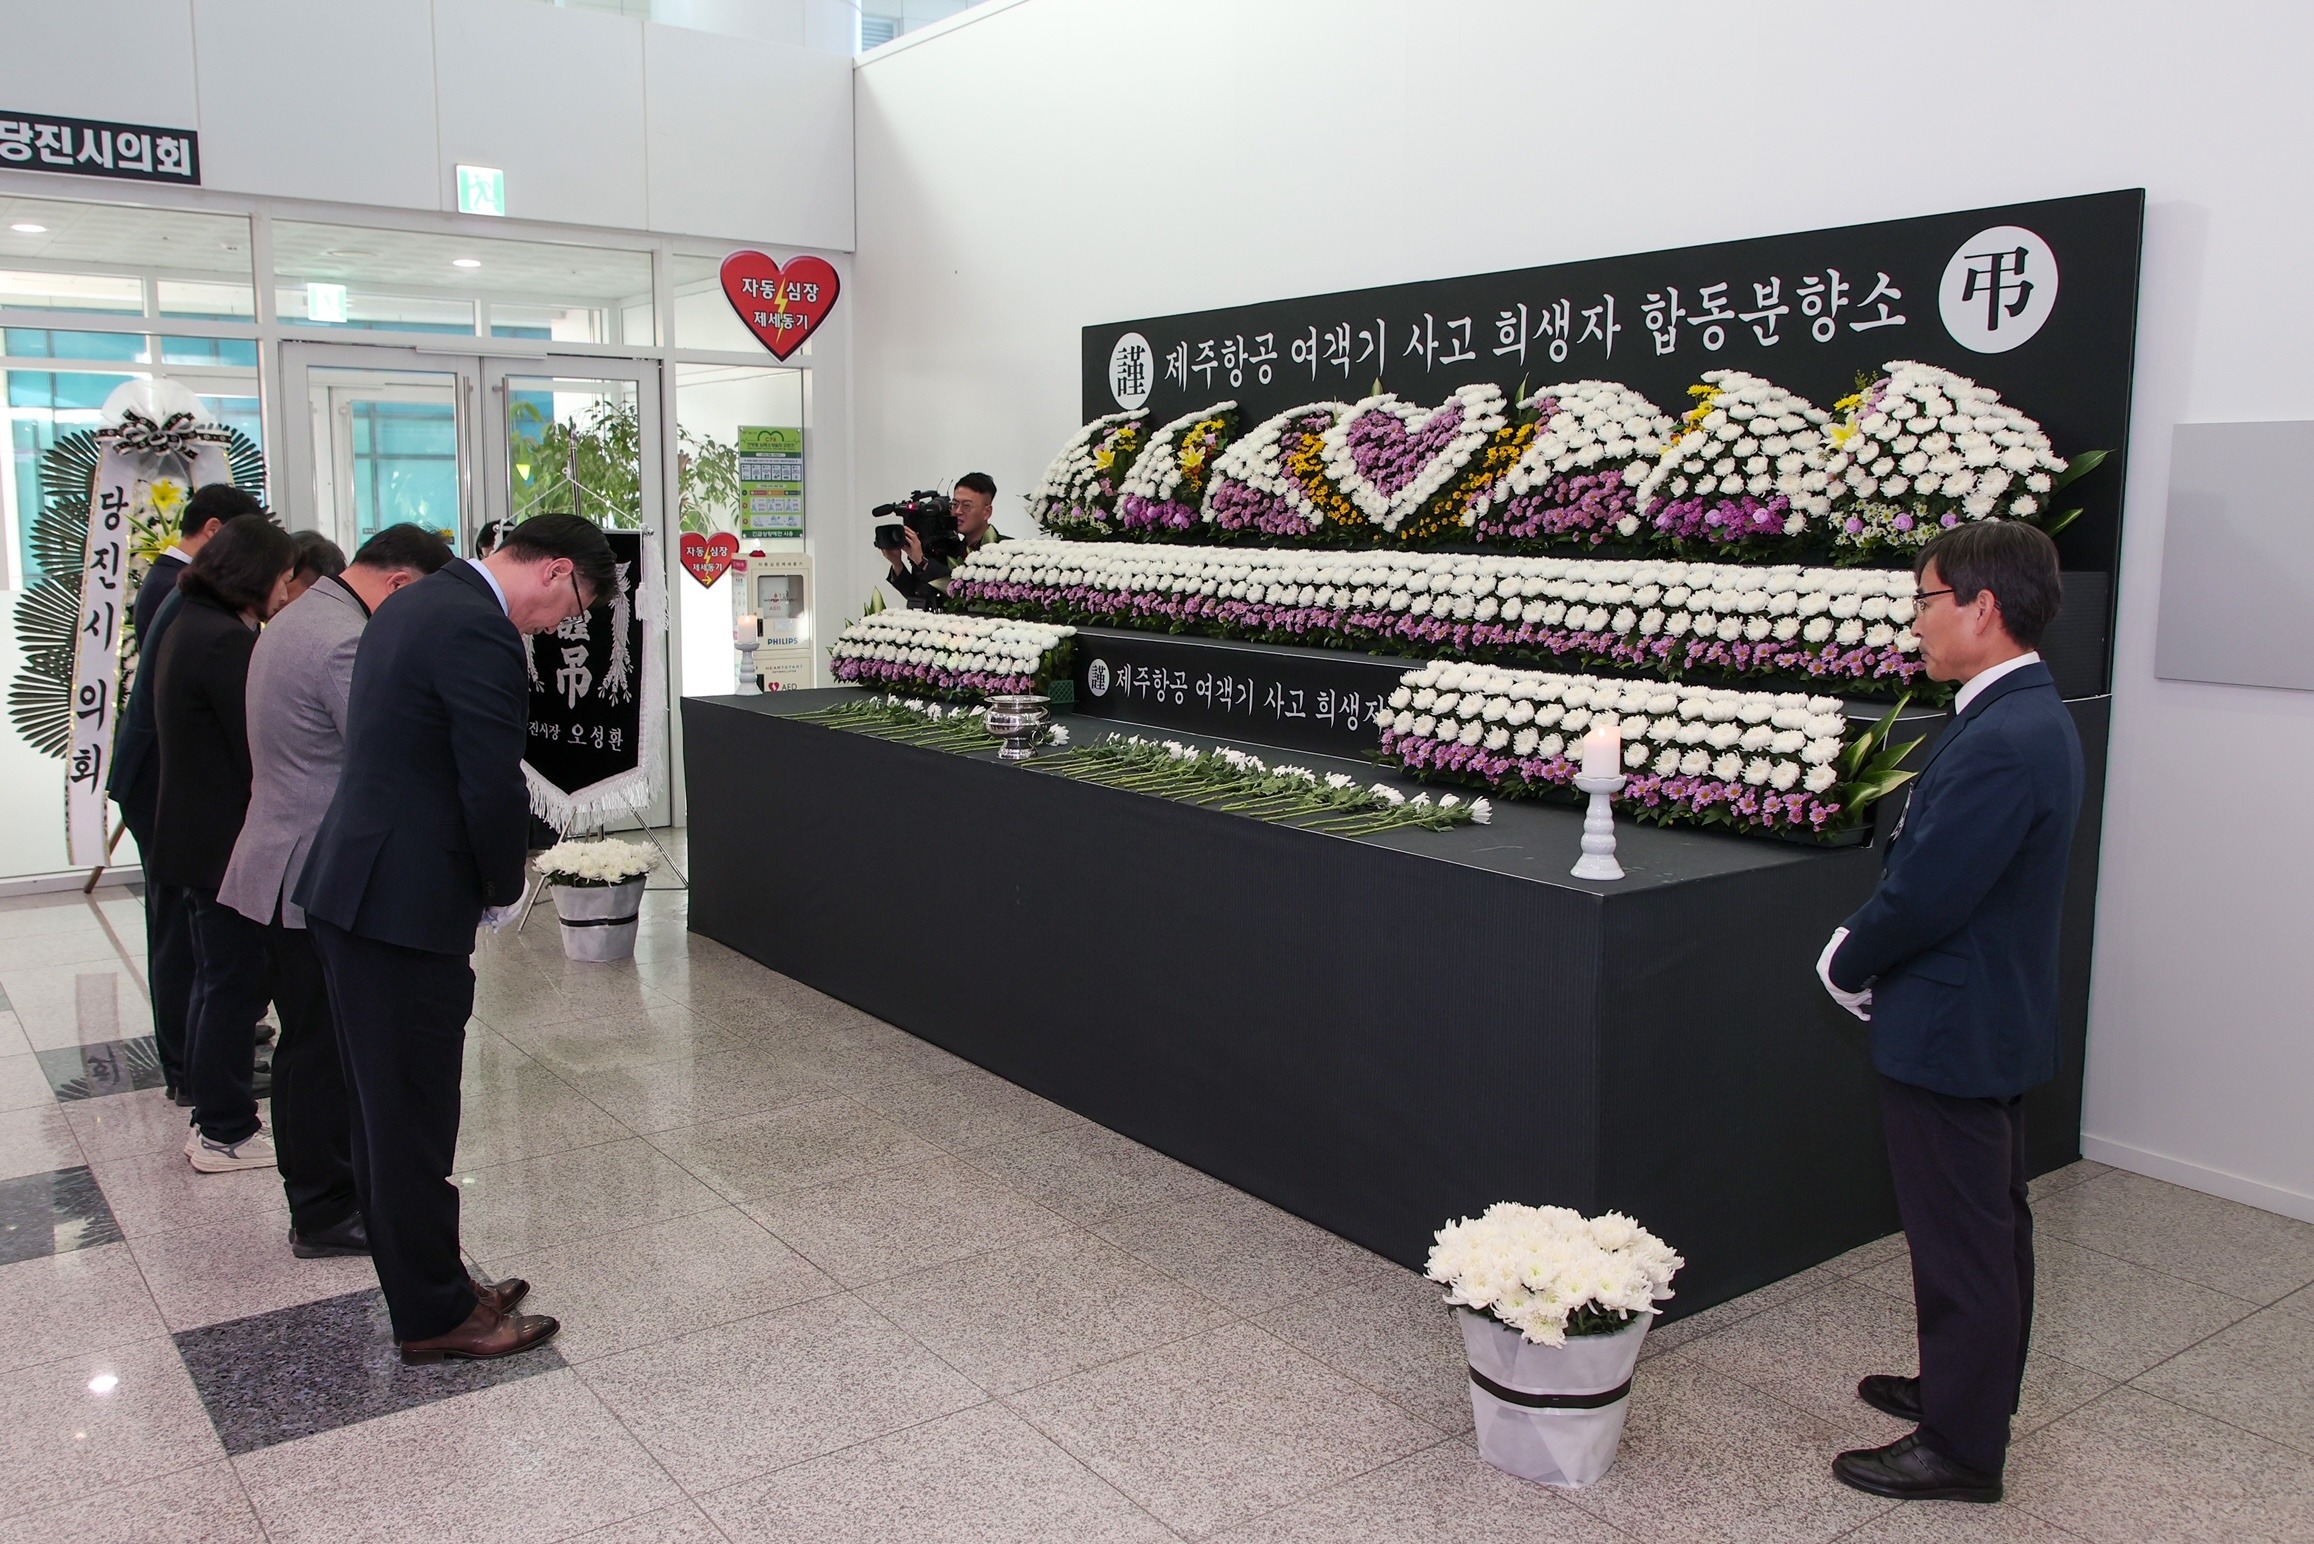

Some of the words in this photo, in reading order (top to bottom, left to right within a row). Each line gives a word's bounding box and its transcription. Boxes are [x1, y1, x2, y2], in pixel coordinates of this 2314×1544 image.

[0, 119, 192, 177] 당진시의회
[742, 278, 776, 300] 자동
[786, 282, 820, 303] 심장
[753, 311, 809, 330] 제세동기
[1116, 346, 1147, 398] 謹
[1164, 332, 1279, 393] 제주항공
[1290, 317, 1386, 382] 여객기
[1402, 312, 1477, 374] 사고
[1492, 293, 1622, 367] 희생자
[1640, 267, 1906, 357] 합동분향소
[1961, 246, 2035, 331] 弔
[686, 546, 704, 557] 자동
[710, 546, 728, 557] 심장
[692, 563, 723, 572] 제세동기
[70, 485, 129, 795] 당진시의회
[1090, 665, 1106, 691] 謹
[1115, 663, 1188, 706] 제주항공
[1195, 672, 1254, 716] 여객기
[1263, 681, 1307, 720] 사고
[527, 721, 561, 741] 진시장
[567, 723, 623, 752] 오성환
